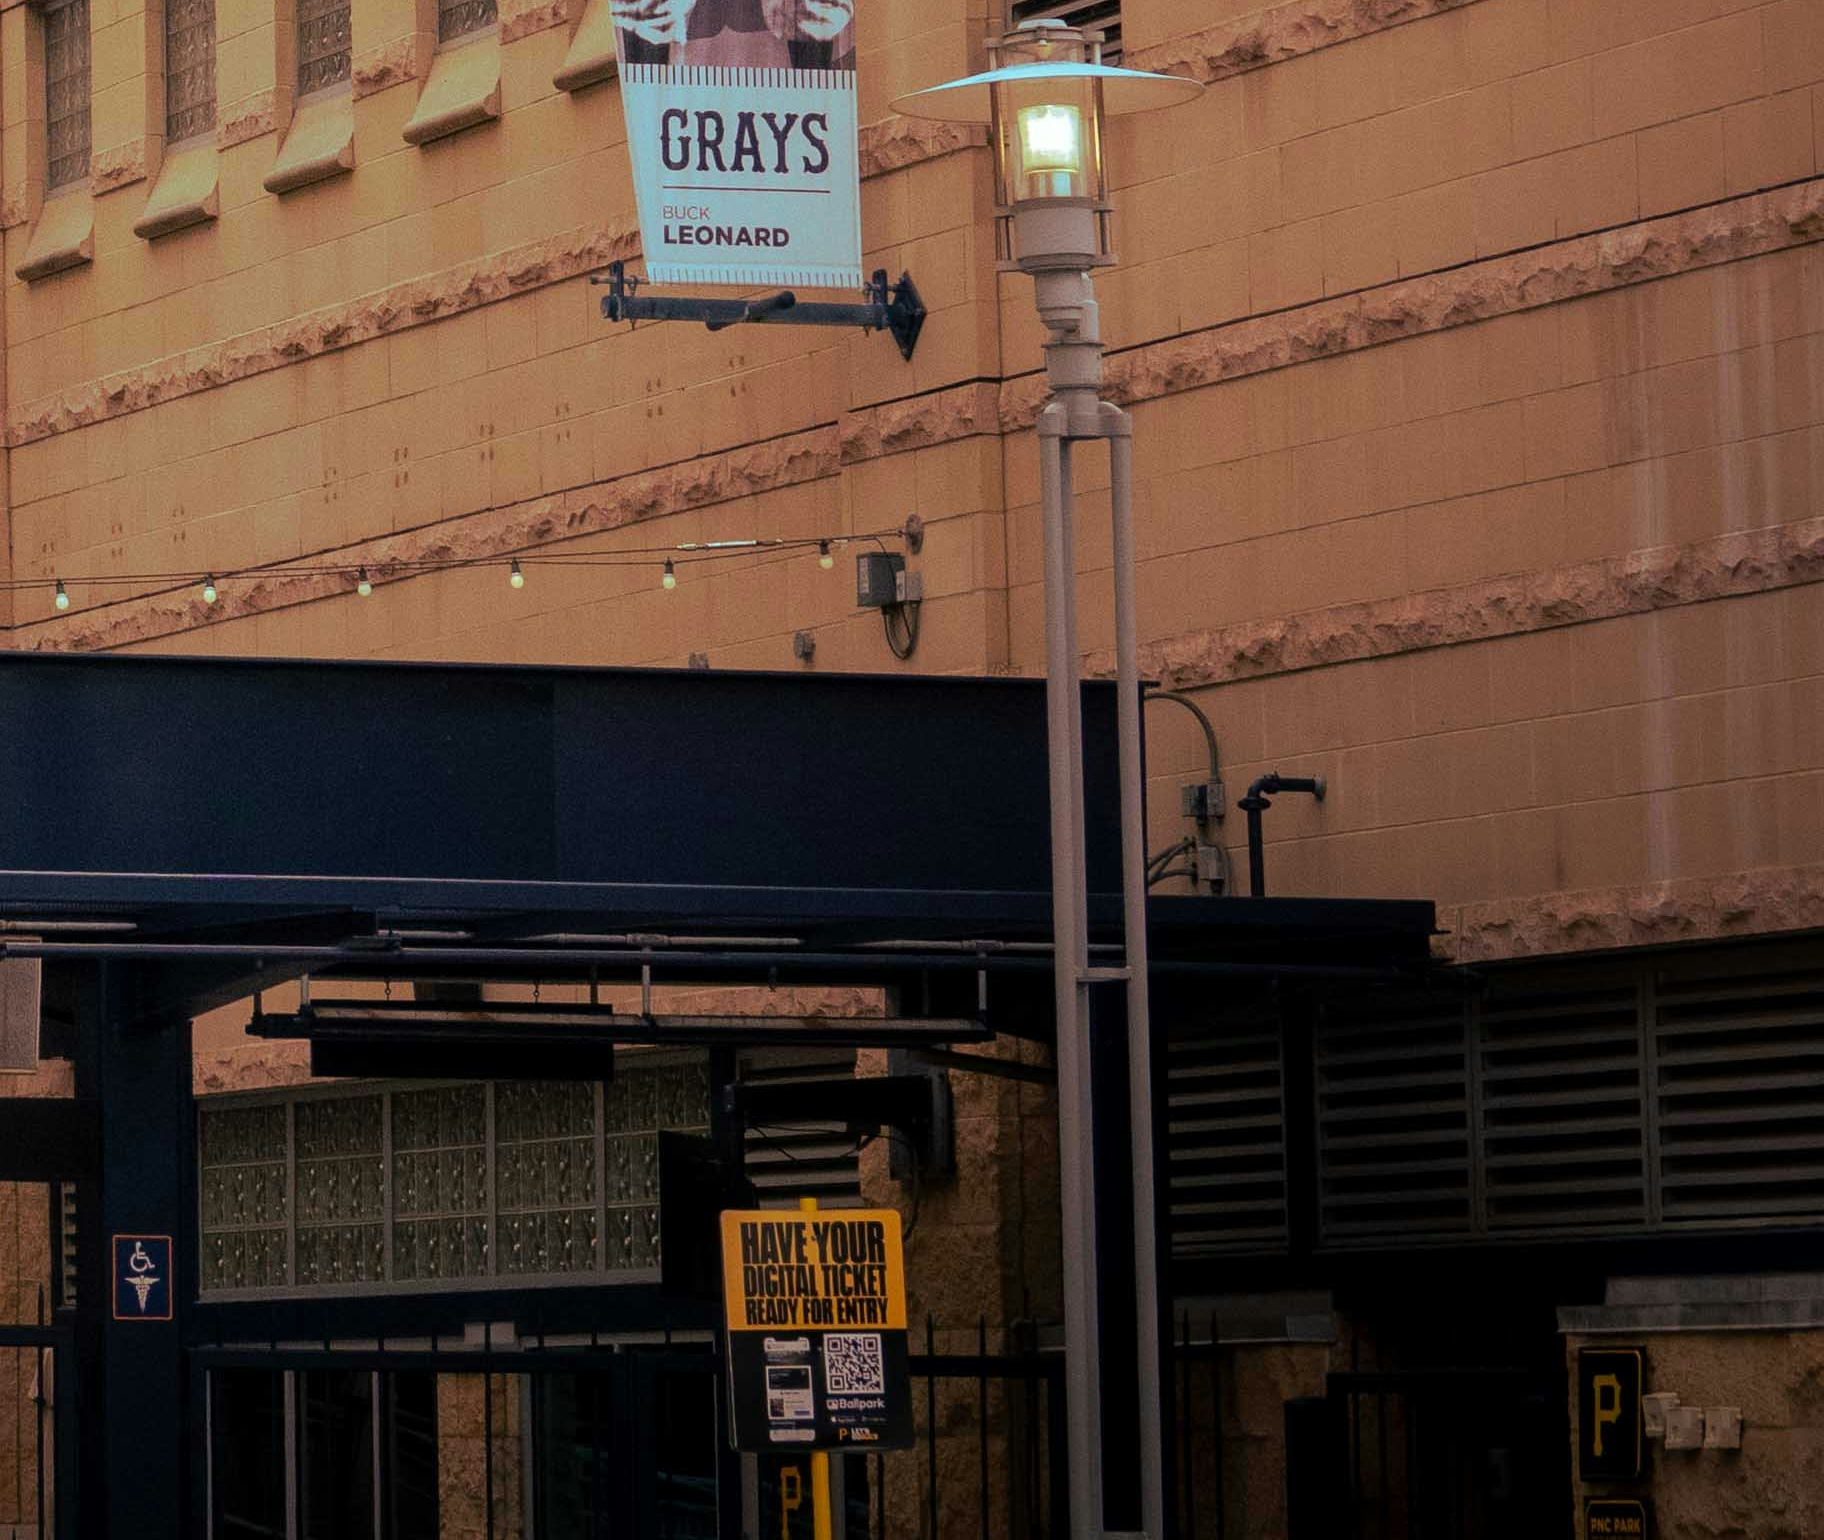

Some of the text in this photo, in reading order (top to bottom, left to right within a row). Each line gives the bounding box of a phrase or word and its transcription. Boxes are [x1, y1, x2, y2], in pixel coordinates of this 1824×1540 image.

[660, 108, 830, 174] GRAYS
[663, 206, 710, 221] BUCK
[663, 225, 790, 247] LEONARD
[740, 1220, 886, 1264] HAVE YOUR
[743, 1264, 888, 1297] DIGITAL TICKET
[745, 1297, 889, 1325] READY FOR ENTRY
[839, 1398, 886, 1410] Ballpark
[1592, 1373, 1622, 1458] P
[1590, 1518, 1642, 1533] PNC PARK
